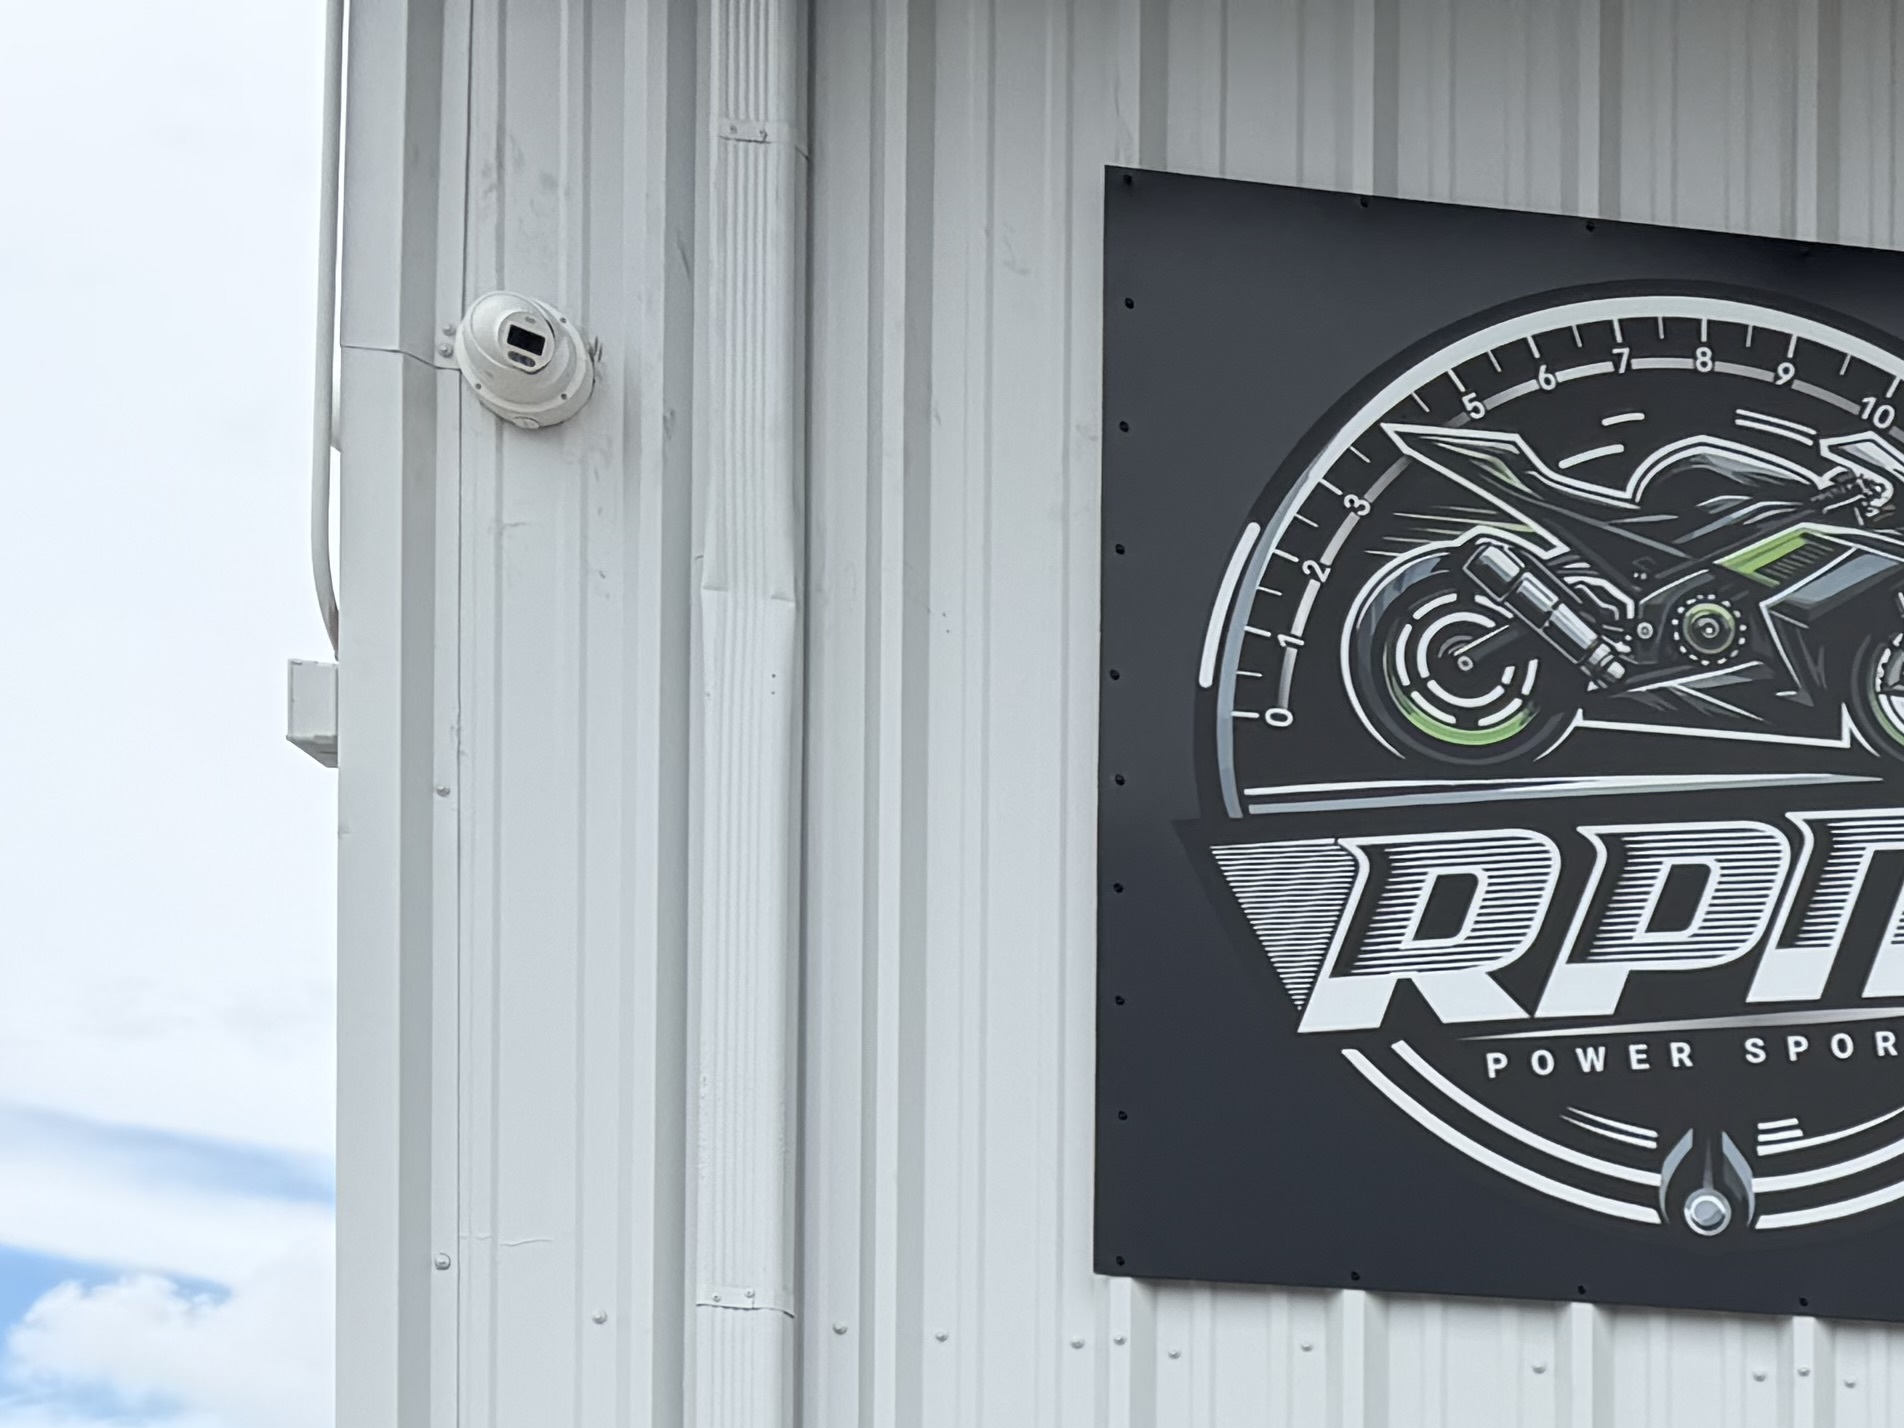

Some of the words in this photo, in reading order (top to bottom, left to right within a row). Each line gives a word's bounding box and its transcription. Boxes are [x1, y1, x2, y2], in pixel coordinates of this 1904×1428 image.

[1612, 347, 1630, 373] 7
[1695, 347, 1713, 372] 8
[1537, 364, 1557, 390] 6
[1774, 362, 1796, 386] 9
[1462, 392, 1486, 419] 5
[1860, 397, 1896, 429] 10
[1344, 494, 1371, 516] 3
[1302, 560, 1331, 582] 2
[1278, 634, 1305, 648] 1
[1265, 708, 1294, 727] 0
[1486, 1041, 1694, 1078] POWER
